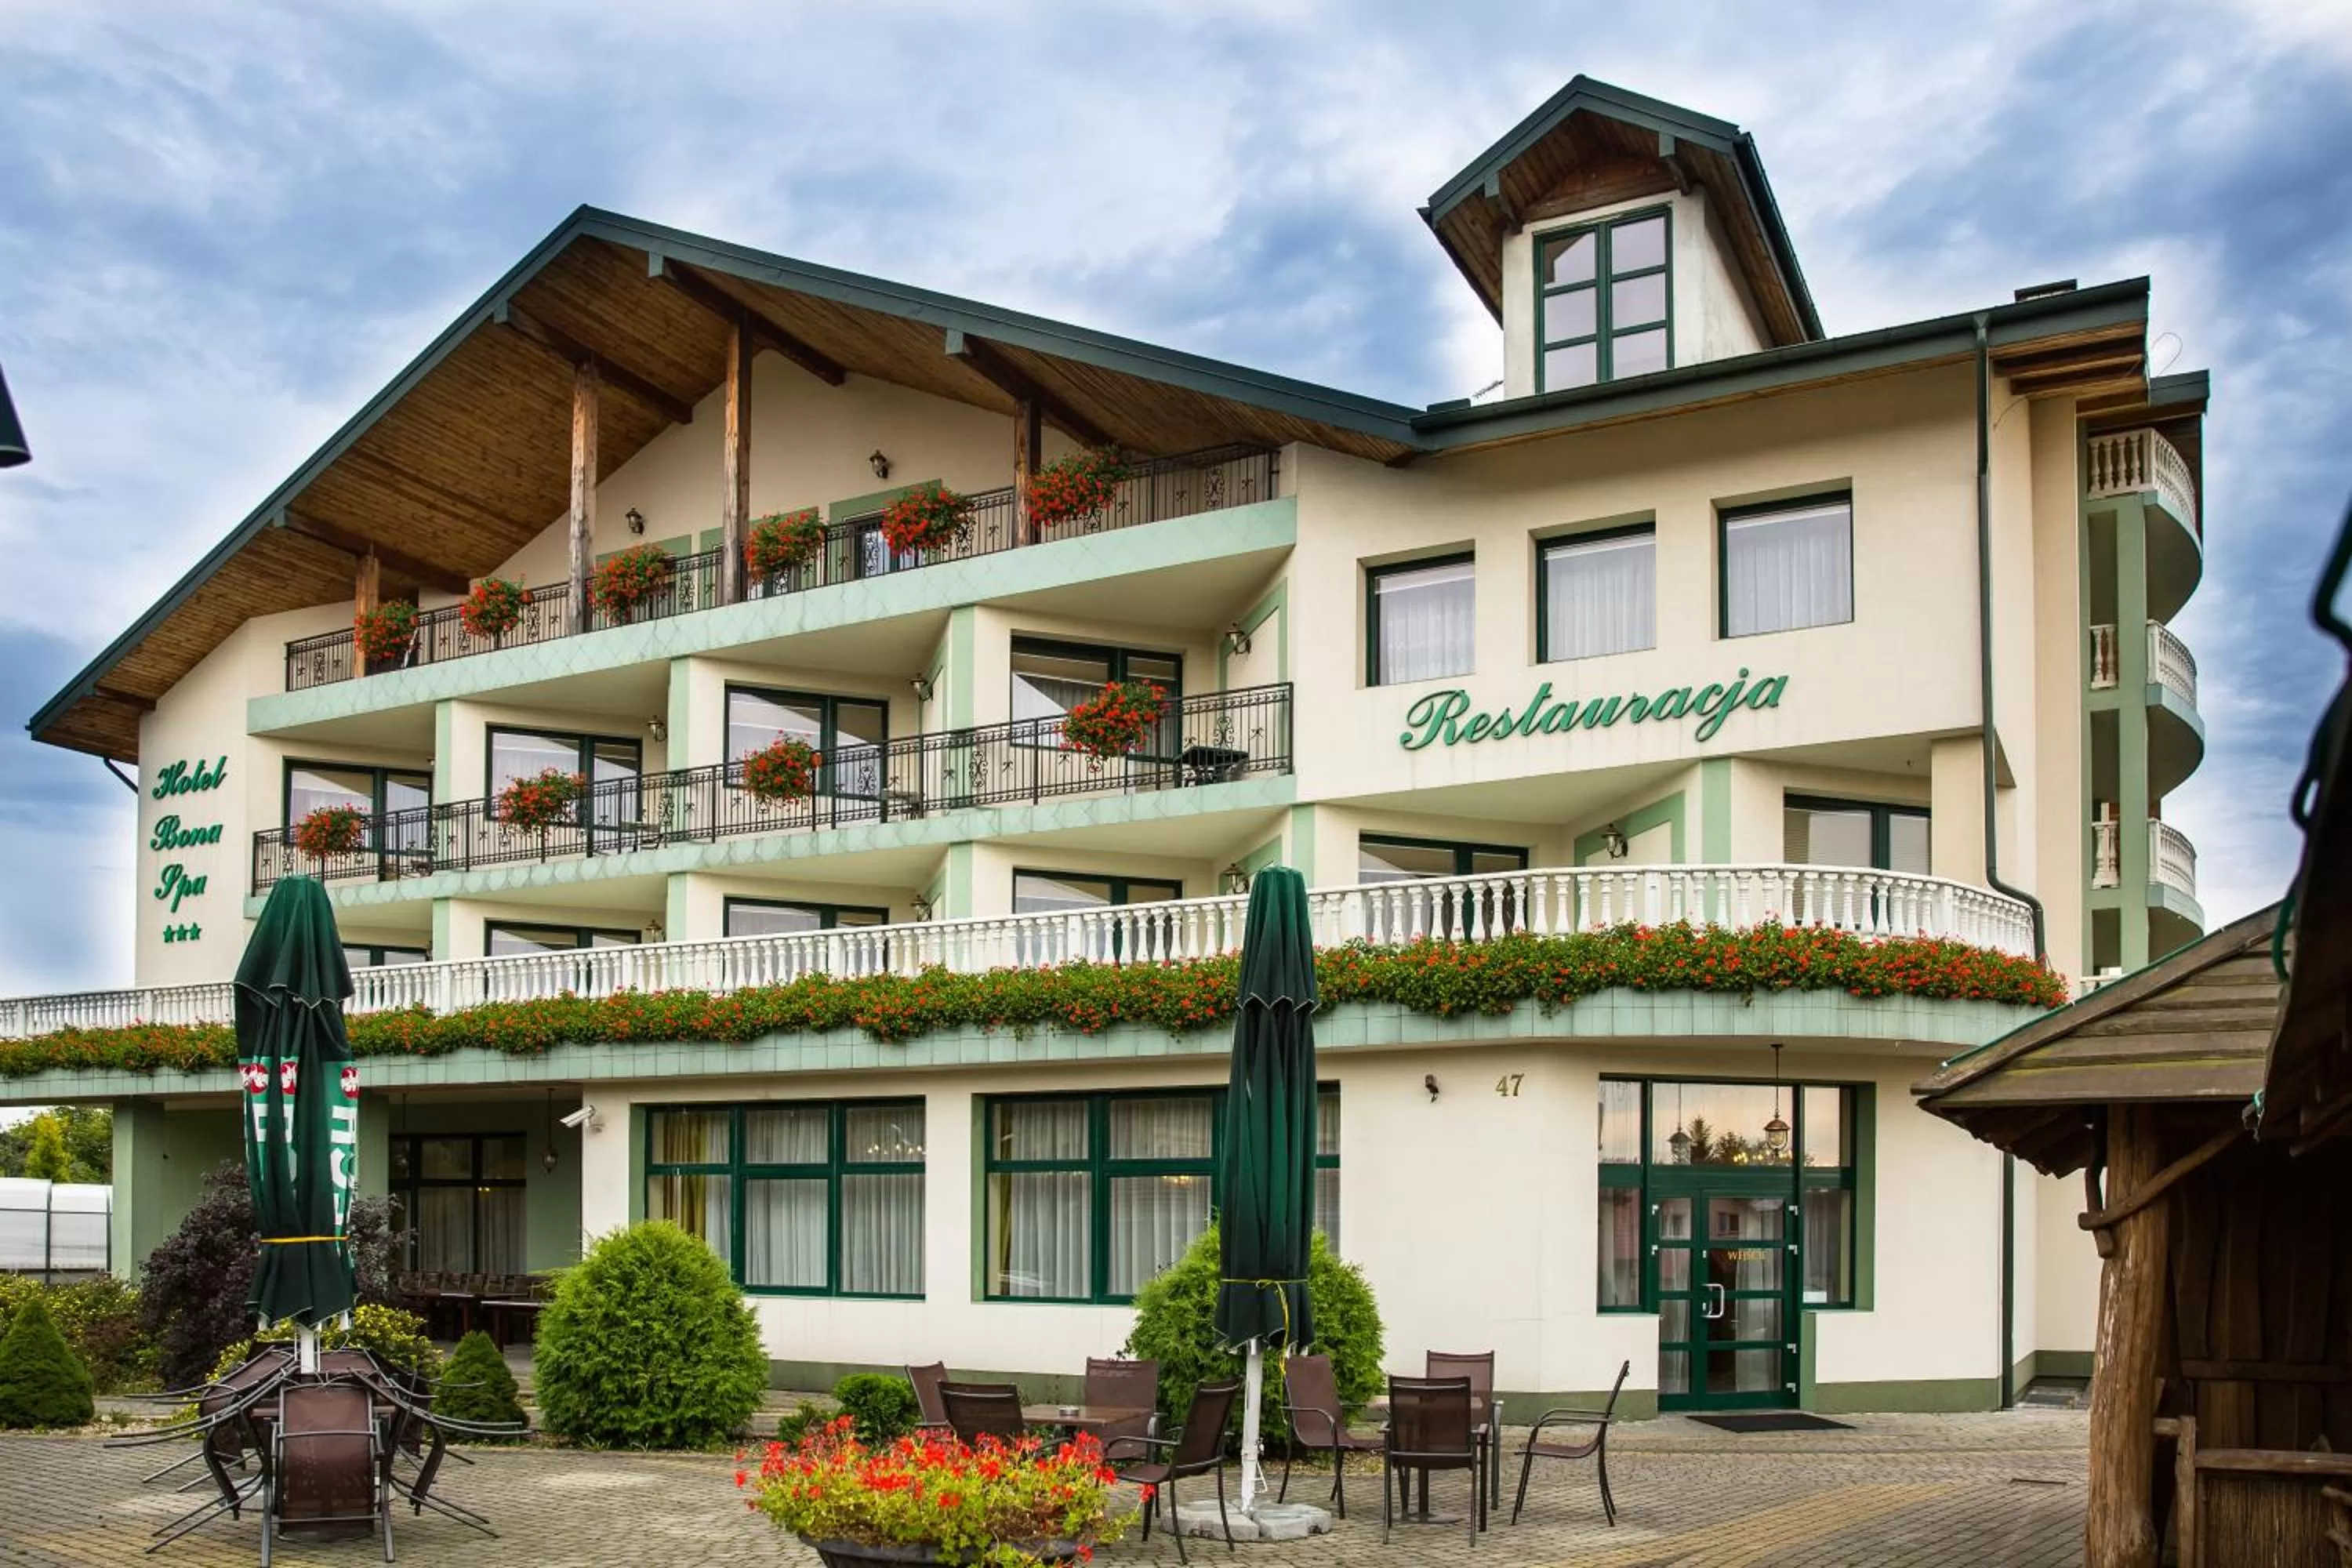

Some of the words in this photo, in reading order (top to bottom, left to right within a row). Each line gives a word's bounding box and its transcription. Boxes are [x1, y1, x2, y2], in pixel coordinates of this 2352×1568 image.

[1399, 667, 1789, 750] Restauracja
[152, 755, 227, 800] Hotel
[151, 815, 223, 851] Bona
[154, 863, 208, 913] Spa
[1495, 1073, 1524, 1097] 47
